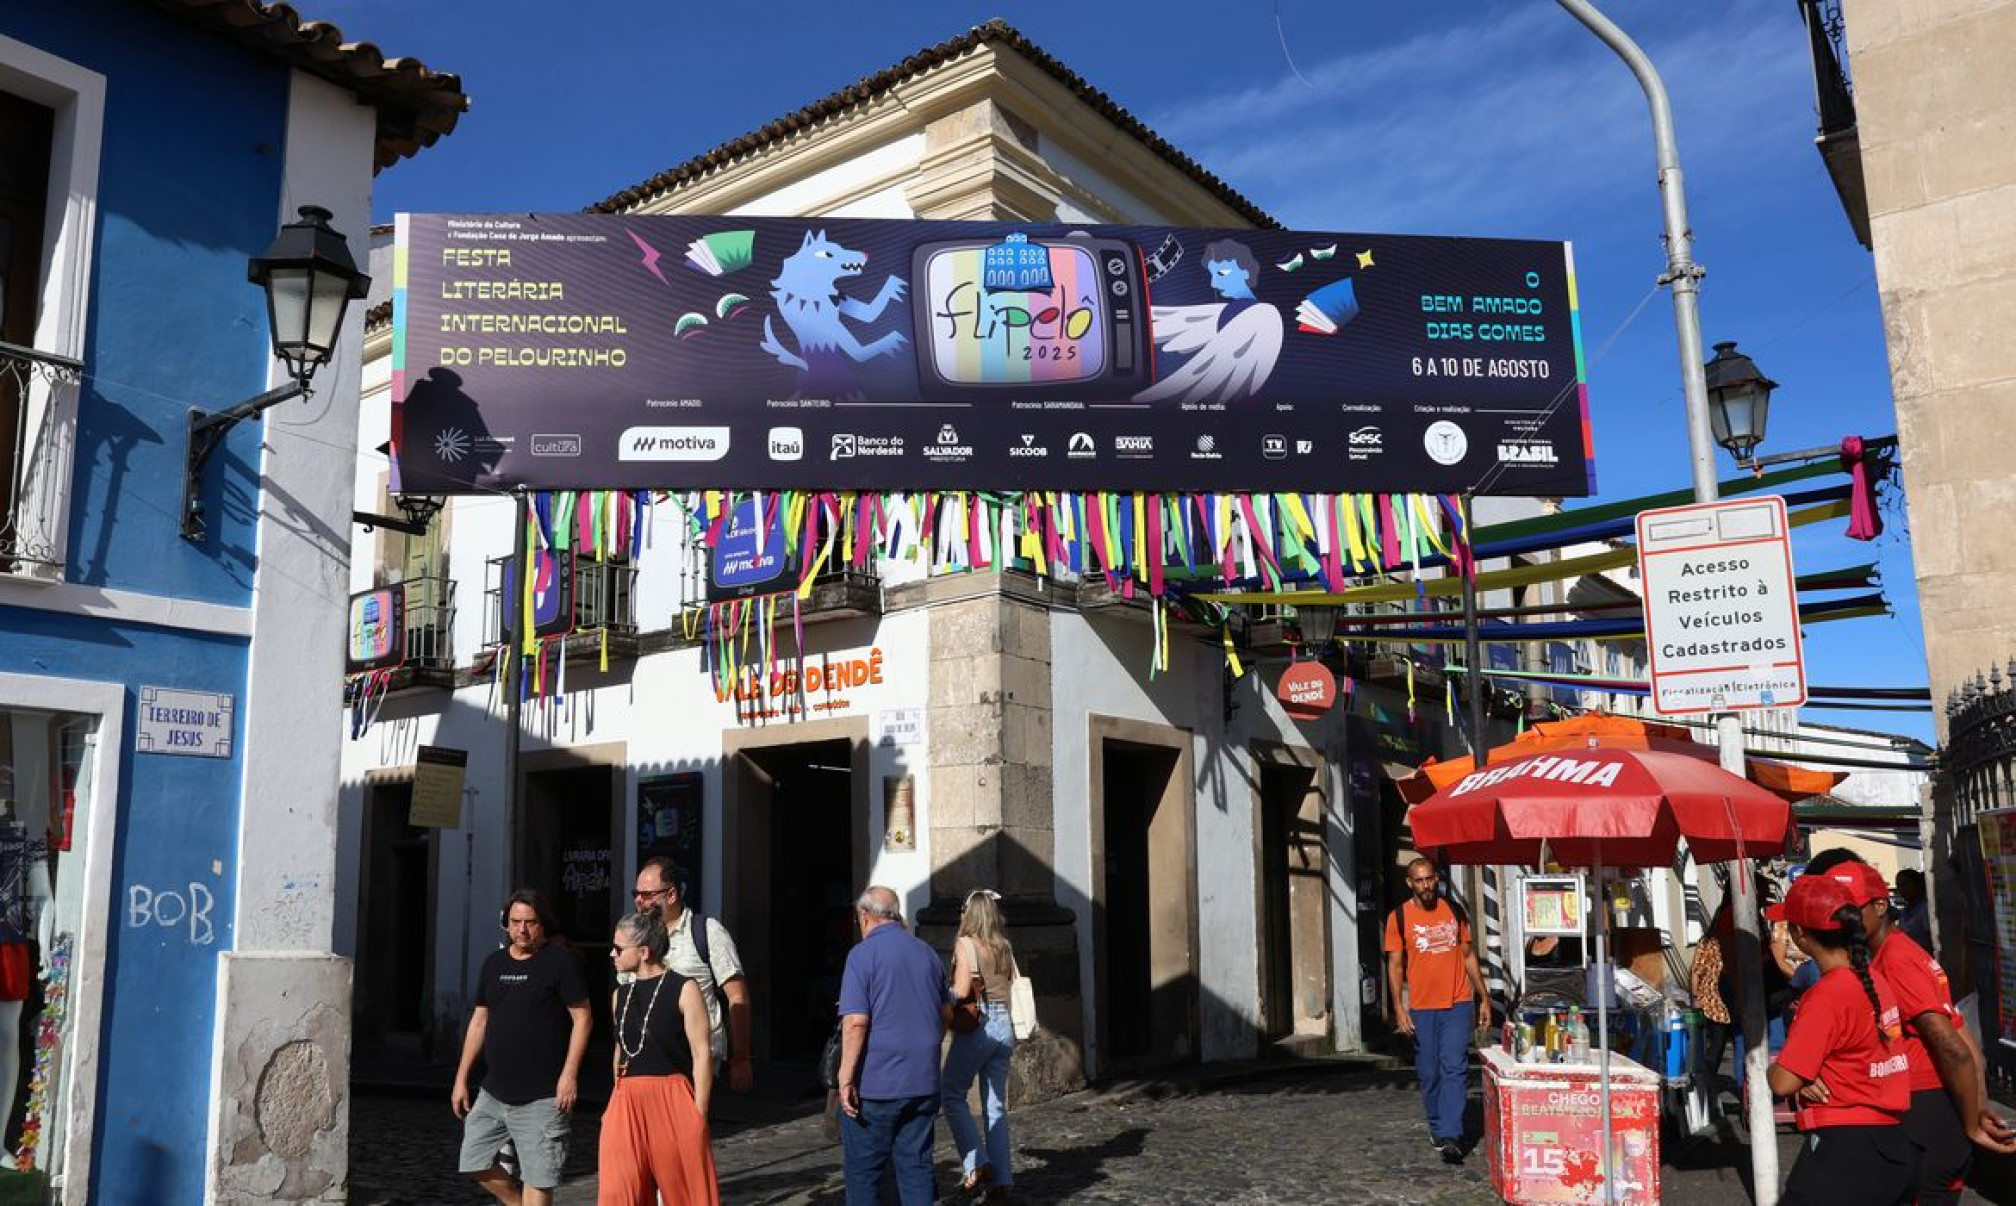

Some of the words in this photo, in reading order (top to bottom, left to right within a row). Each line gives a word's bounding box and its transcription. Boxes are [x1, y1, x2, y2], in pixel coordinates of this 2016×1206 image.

[443, 248, 510, 267] FESTA
[441, 278, 564, 300] LITERÁRIA
[1526, 271, 1540, 288] O
[1421, 295, 1463, 313] BEM
[1473, 296, 1543, 315] AMADO
[440, 314, 628, 334] INTERNACIONAL
[1426, 322, 1474, 340] DIAS
[440, 347, 471, 366] DO
[478, 348, 627, 367] PELOURINHO
[1023, 346, 1076, 360] 2025
[1412, 357, 1423, 377] 6
[1427, 358, 1438, 377] A
[1441, 358, 1458, 377] 10
[1463, 358, 1484, 378] DE
[1488, 359, 1550, 379] AGOSTO
[659, 436, 716, 450] motiva
[772, 440, 799, 454] itaú
[857, 436, 888, 446] Banco
[890, 436, 904, 446] do
[857, 446, 904, 456] Nordeste
[923, 446, 973, 456] SALVADOR
[1009, 447, 1048, 456] SICOOB
[1497, 445, 1559, 463] BRASIL
[1681, 558, 1750, 577] Acesso
[1668, 583, 1748, 604] Restrito
[1757, 578, 1769, 596] à
[1679, 610, 1764, 630] Veículos
[1662, 636, 1787, 659] Cadastrados
[805, 647, 883, 692] DENDÊ
[1288, 681, 1309, 692] VALE
[149, 707, 205, 727] TERREIRO
[206, 711, 221, 728] DE
[166, 730, 203, 747] JESUS
[1448, 754, 1624, 799] BRAHMA
[129, 882, 215, 945] BOB
[1523, 1148, 1564, 1175] 15
